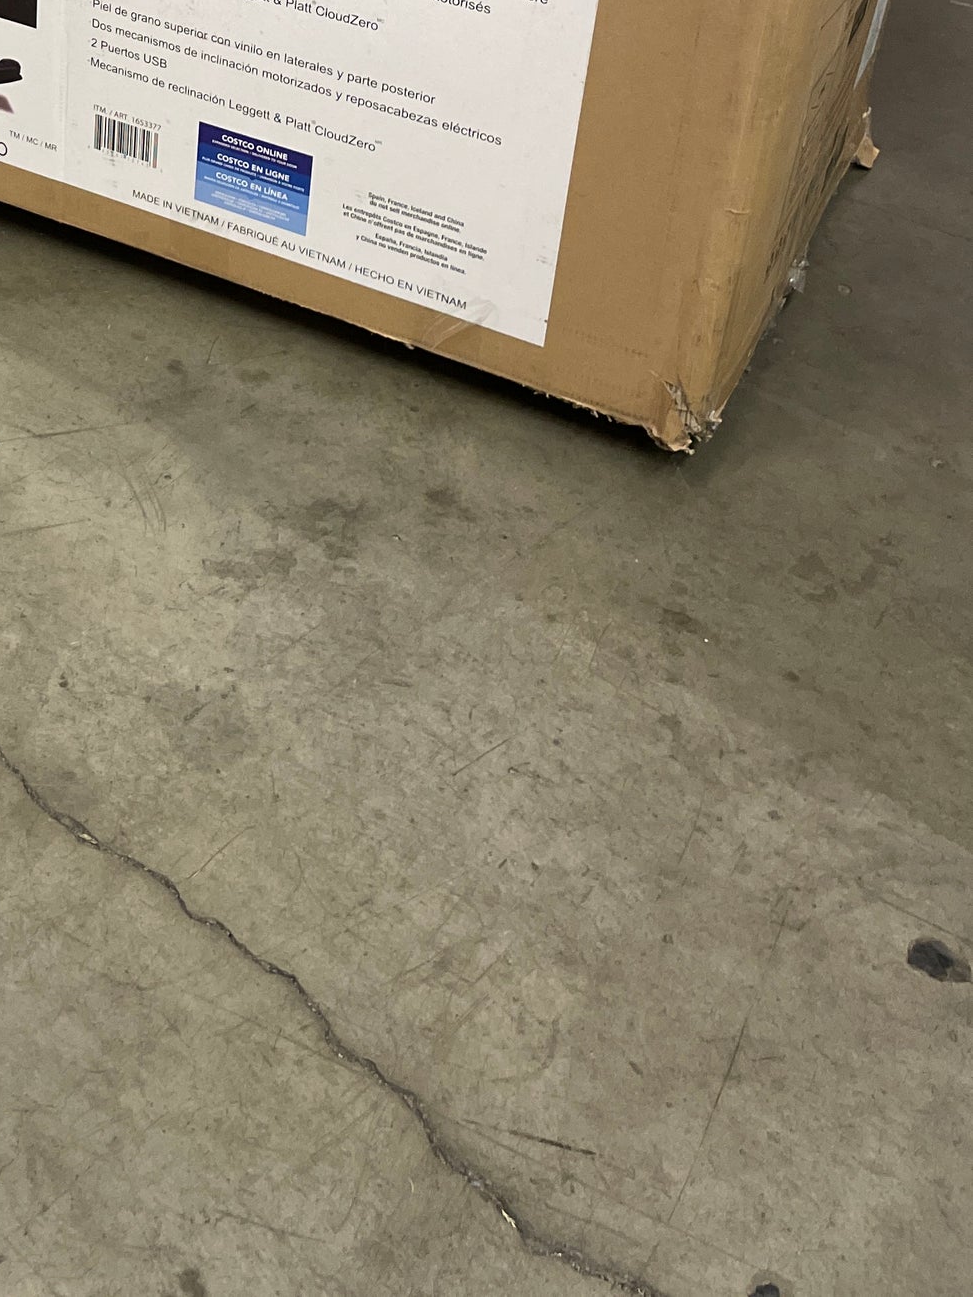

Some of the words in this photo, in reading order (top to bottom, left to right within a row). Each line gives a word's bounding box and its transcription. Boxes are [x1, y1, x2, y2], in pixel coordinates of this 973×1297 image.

[91, 17, 112, 32] Dos
[115, 27, 180, 52] mecanismos
[183, 46, 197, 57] de
[200, 52, 258, 75] inclinación
[261, 70, 331, 96] motorizados
[335, 91, 342, 101] y
[345, 94, 437, 127] reposacabezas
[441, 121, 501, 145] eléctricos
[114, 5, 127, 16] de
[130, 11, 161, 26] grano
[234, 41, 262, 55] vinilo
[266, 50, 280, 60] en
[283, 53, 332, 75] laterales
[336, 70, 343, 80] y
[346, 73, 377, 88] parte
[381, 82, 435, 104] posterior
[216, 153, 249, 168] COSTCO
[251, 163, 263, 173] EN
[264, 168, 289, 182] LIGNE
[221, 134, 254, 150] COSTCO
[255, 145, 287, 160] ONLINE
[212, 171, 248, 187] COSTCO
[249, 182, 261, 192] EN
[263, 186, 287, 200] LÍNEA
[132, 189, 159, 205] MADE
[162, 200, 172, 209] IN
[175, 204, 218, 225] VIETNAM
[227, 221, 278, 246] FABRIQUÉ
[280, 240, 295, 251] AU
[298, 245, 345, 268] VIETNAM
[354, 264, 394, 284] HECHO
[397, 278, 412, 291] EN
[416, 285, 466, 309] VIETNAM
